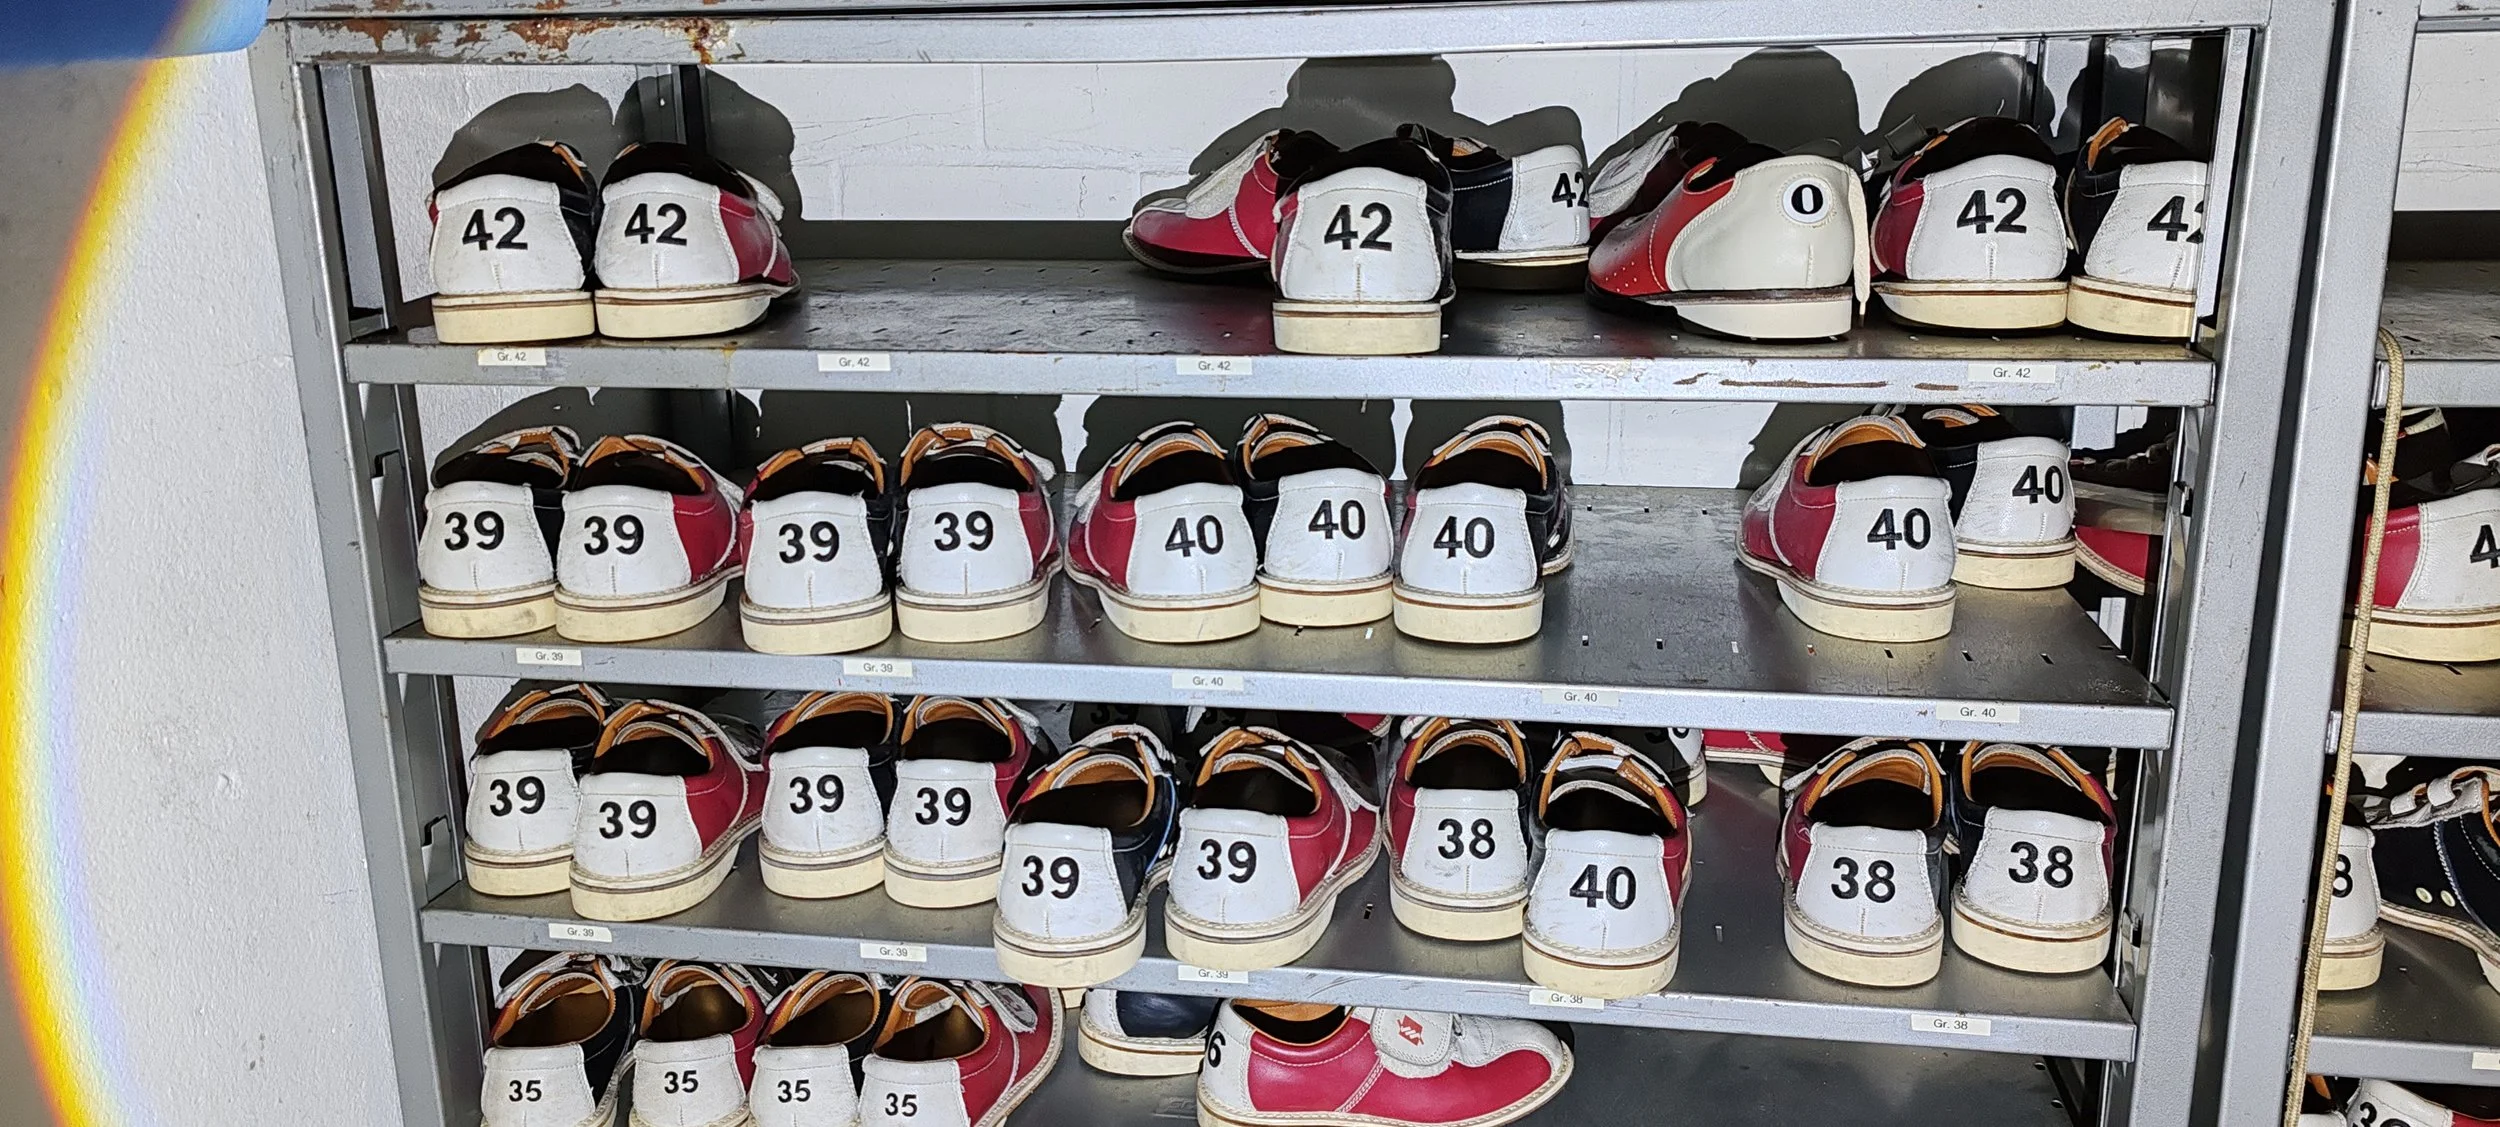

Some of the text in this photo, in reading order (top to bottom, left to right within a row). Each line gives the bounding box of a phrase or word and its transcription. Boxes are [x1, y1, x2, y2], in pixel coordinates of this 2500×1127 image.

[1551, 171, 1589, 208] 42
[462, 207, 527, 250] 42
[625, 203, 687, 245] 42
[1324, 203, 1392, 251] 42
[1957, 188, 2026, 234] 42
[497, 351, 527, 362] Gr. 42
[839, 357, 870, 367] Gr. 42
[1198, 360, 1230, 370] Gr. 42
[1993, 367, 2031, 378] Gr. 42
[2013, 463, 2065, 504] 40
[445, 511, 504, 551] 39
[584, 515, 644, 555] 39
[935, 511, 993, 551] 39
[1165, 515, 1223, 557] 40
[1309, 500, 1365, 539] 40
[1434, 516, 1494, 558] 40
[1868, 508, 1930, 550] 40
[779, 521, 839, 563] 39
[535, 651, 564, 661] Gr. 39
[863, 662, 893, 673] Gr. 39
[1193, 676, 1223, 686] Gr. 40
[1564, 691, 1598, 702] Gr. 40
[1960, 706, 1997, 718] Gr. 40
[490, 776, 545, 816] 39
[790, 775, 844, 814] 39
[916, 788, 971, 826] 39
[600, 800, 656, 839] 39
[1438, 819, 1495, 859] 38
[1022, 856, 1079, 899] 39
[1197, 839, 1256, 883] 39
[1831, 857, 1895, 903] 38
[2009, 842, 2073, 888] 38
[1570, 865, 1636, 909] 40
[567, 927, 595, 937] Gr. 39
[880, 946, 908, 957] Gr. 39
[1198, 969, 1229, 979] Gr. 39
[1551, 993, 1583, 1004] Gr. 38
[1934, 1018, 1968, 1030] Gr. 38
[509, 1080, 541, 1101] 35
[665, 1070, 698, 1093] 35
[778, 1080, 810, 1103] 35
[886, 1093, 917, 1116] 35
